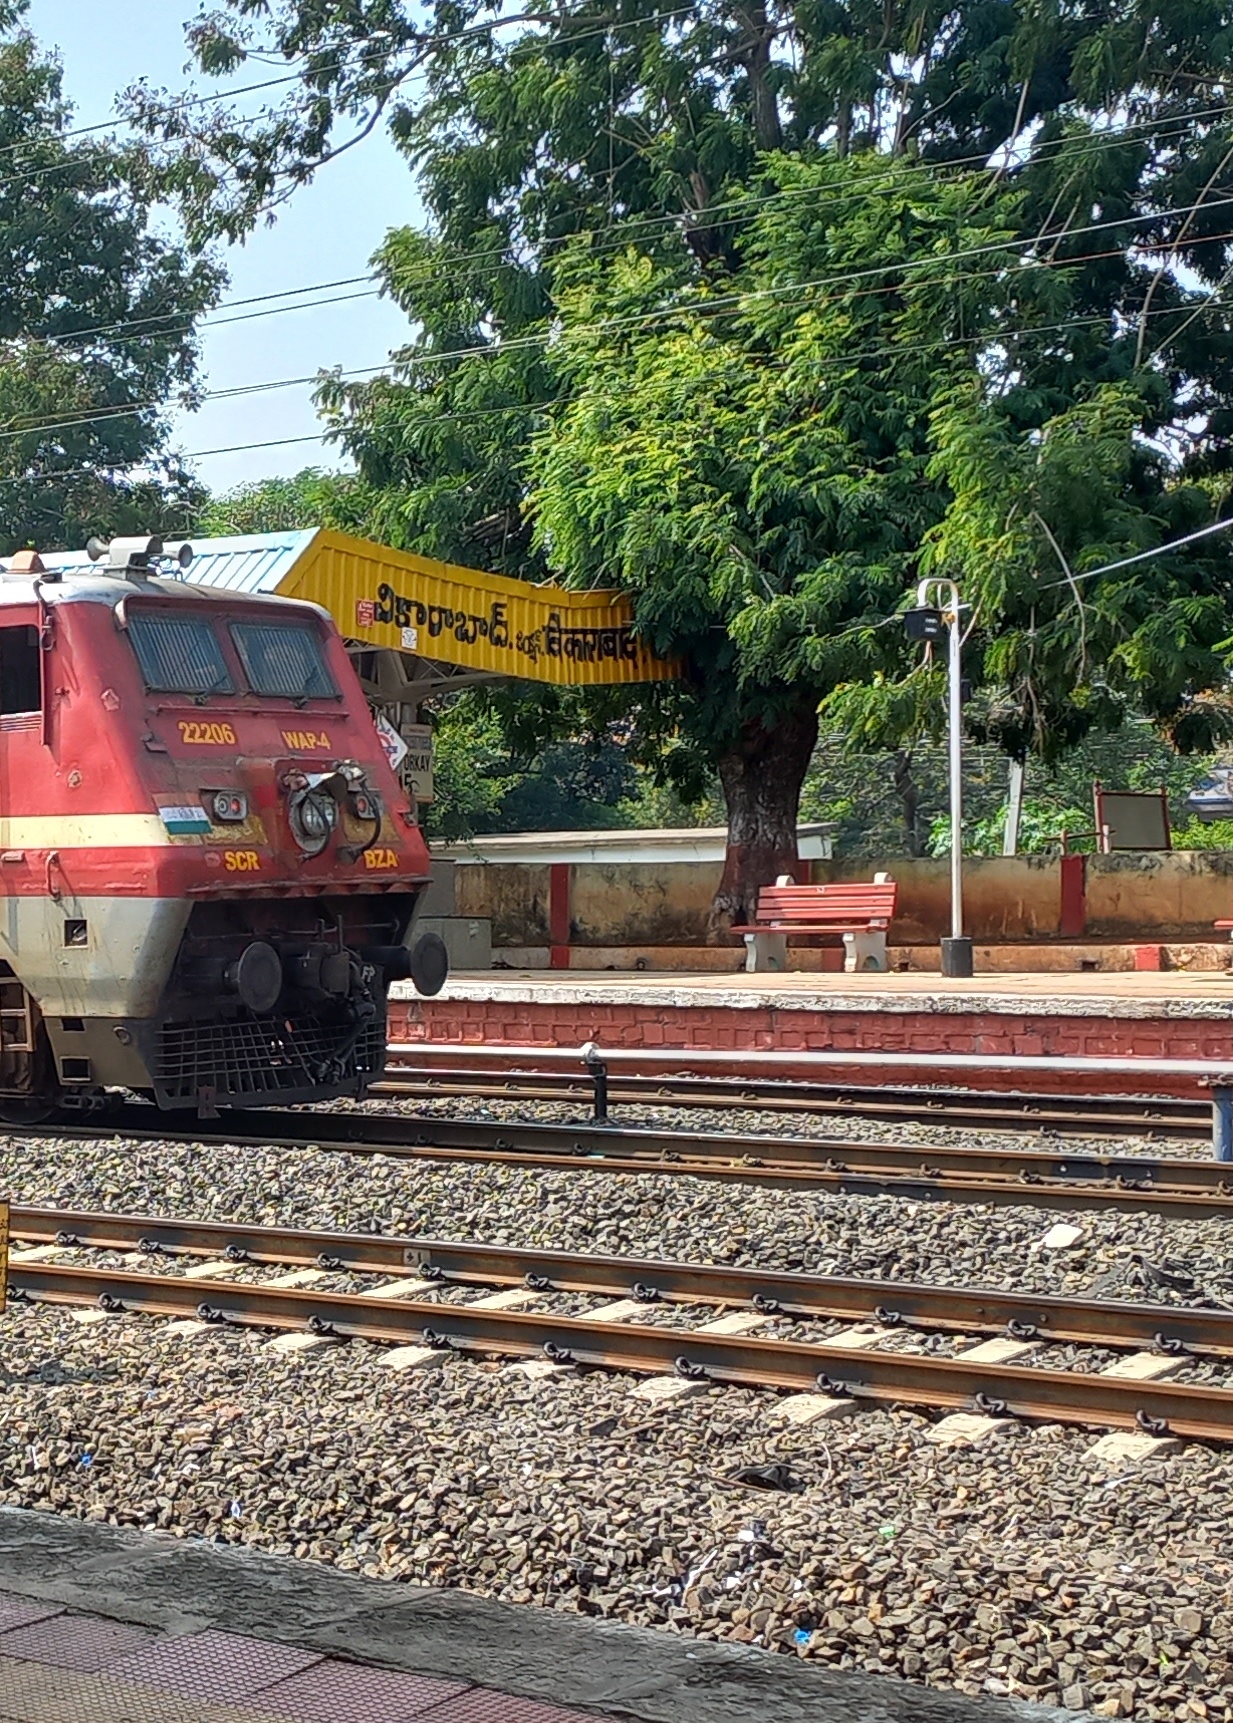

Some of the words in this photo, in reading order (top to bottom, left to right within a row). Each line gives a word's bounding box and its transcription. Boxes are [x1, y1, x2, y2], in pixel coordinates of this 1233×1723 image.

[178, 721, 236, 745] 22206
[282, 730, 331, 750] WAP-4
[224, 851, 260, 871] SCR
[364, 850, 398, 870] BZA
